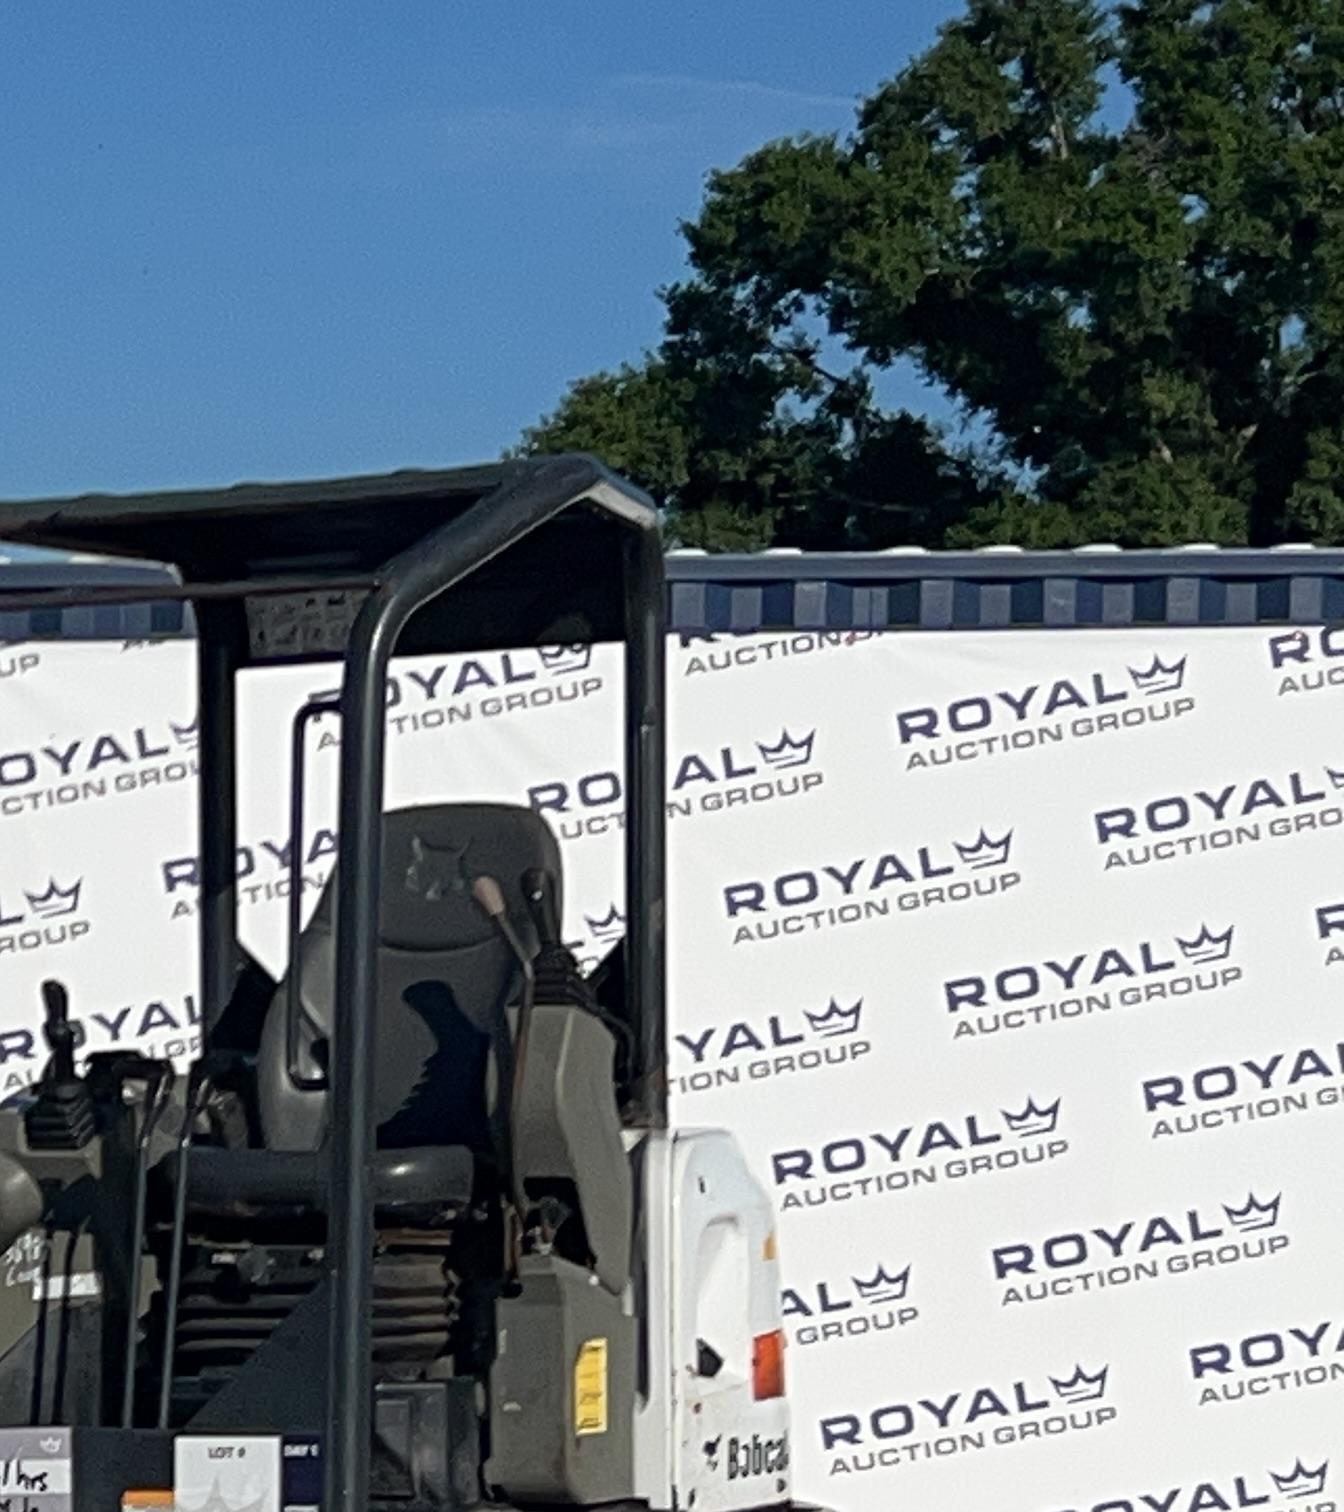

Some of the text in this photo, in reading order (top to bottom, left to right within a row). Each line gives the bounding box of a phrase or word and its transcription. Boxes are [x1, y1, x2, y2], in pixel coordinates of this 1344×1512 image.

[685, 632, 841, 676] AUCTION
[479, 677, 603, 717] GROUP
[896, 672, 1129, 745] ROYAL
[906, 697, 1195, 771] AUCTION GROUP
[700, 772, 824, 812] GROUP
[1094, 771, 1327, 845] ROYAL
[723, 846, 955, 919] ROYAL
[1103, 823, 1261, 871] AUCTION
[733, 871, 1021, 945] AUCTION GROUP
[943, 941, 1177, 1014] ROYAL
[953, 966, 1243, 1040] AUCTION GROUP
[747, 1040, 871, 1080] GROUP
[770, 1114, 1003, 1186] ROYAL
[1151, 1092, 1308, 1139] AUCTION
[780, 1139, 1069, 1211] AUCTION GROUP
[991, 1209, 1224, 1281] ROYAL
[1001, 1234, 1290, 1307] AUCTION GROUP
[795, 1306, 919, 1346] GROUP
[819, 1381, 1051, 1451] ROYAL
[829, 1406, 1117, 1476] AUCTION GROUP
[16, 1459, 48, 1491] hrs
